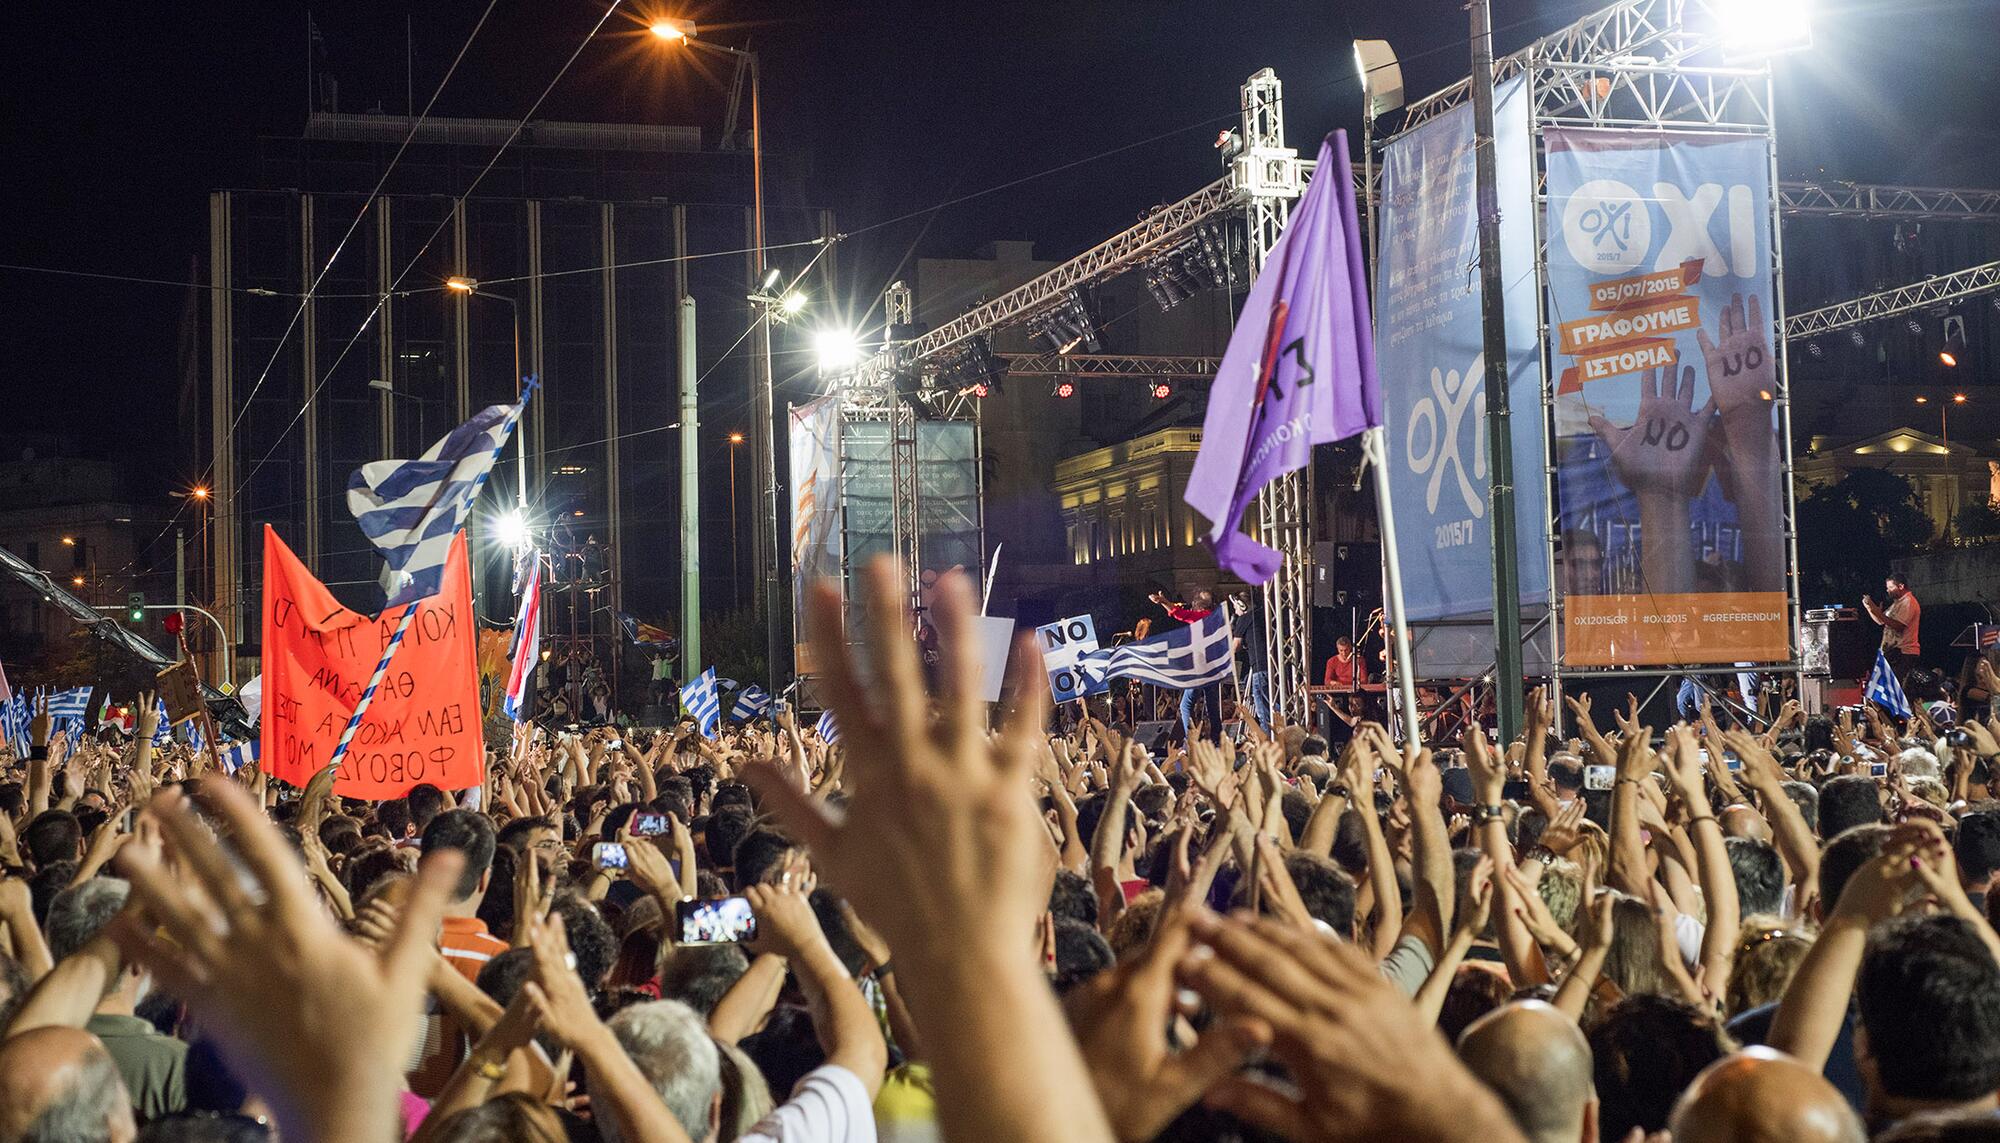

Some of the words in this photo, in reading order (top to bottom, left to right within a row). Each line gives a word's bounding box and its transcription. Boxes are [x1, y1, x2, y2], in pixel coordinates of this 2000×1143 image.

[1596, 277, 1680, 301] 05/07/2015
[1572, 306, 1691, 345] ΓΡΑΦΟΥΜΕ
[1585, 346, 1672, 378] ΙΣΤΟΡΙΑ
[1640, 417, 1690, 451] NO
[1435, 519, 1474, 549] 2015/7
[1642, 614, 1688, 624] #OXI2015
[1702, 612, 1781, 622] #GREFERENDUM
[1045, 621, 1088, 648] NO
